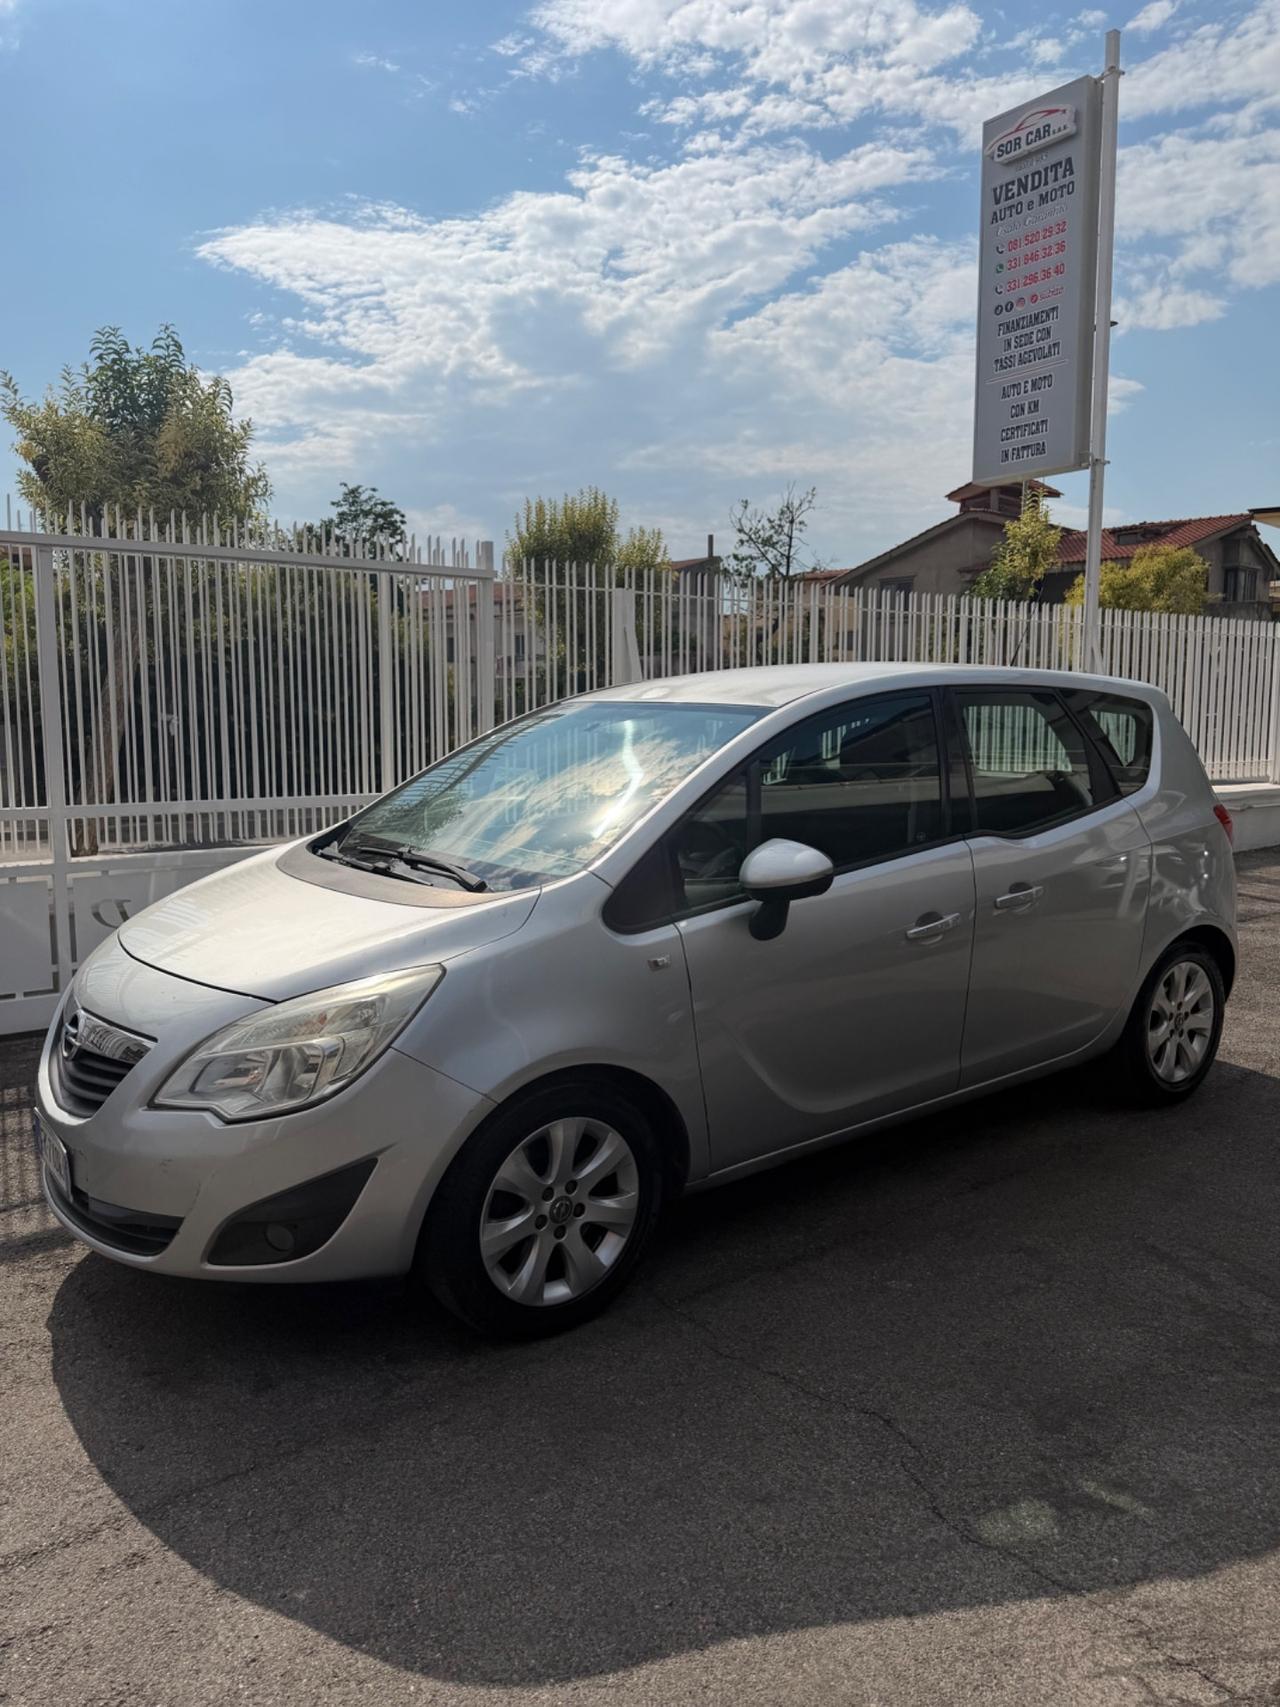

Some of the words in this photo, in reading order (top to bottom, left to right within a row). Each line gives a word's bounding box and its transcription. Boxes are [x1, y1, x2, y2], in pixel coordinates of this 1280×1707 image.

[997, 137, 1022, 159] SOR
[1025, 124, 1051, 146] CAR
[992, 156, 1075, 206] VENDITA
[990, 201, 1023, 225] AUTO
[1027, 200, 1035, 212] e
[1038, 181, 1075, 207] MOTO
[998, 306, 1059, 337] FINANZIAMENTI
[1004, 338, 1012, 352] IN
[1014, 333, 1034, 349] SEDE
[1036, 326, 1052, 342] CON
[994, 356, 1017, 372] TASSI
[1018, 342, 1060, 367] AGEVOLATI
[1001, 382, 1022, 400] AUTO
[1023, 380, 1029, 394] E
[1031, 374, 1053, 392] MOTO
[1010, 404, 1026, 419] CON
[1028, 400, 1040, 415] KM
[1001, 419, 1048, 442] CERTIFICATI
[1001, 449, 1010, 463] IN
[1011, 442, 1046, 461] FATTURA
